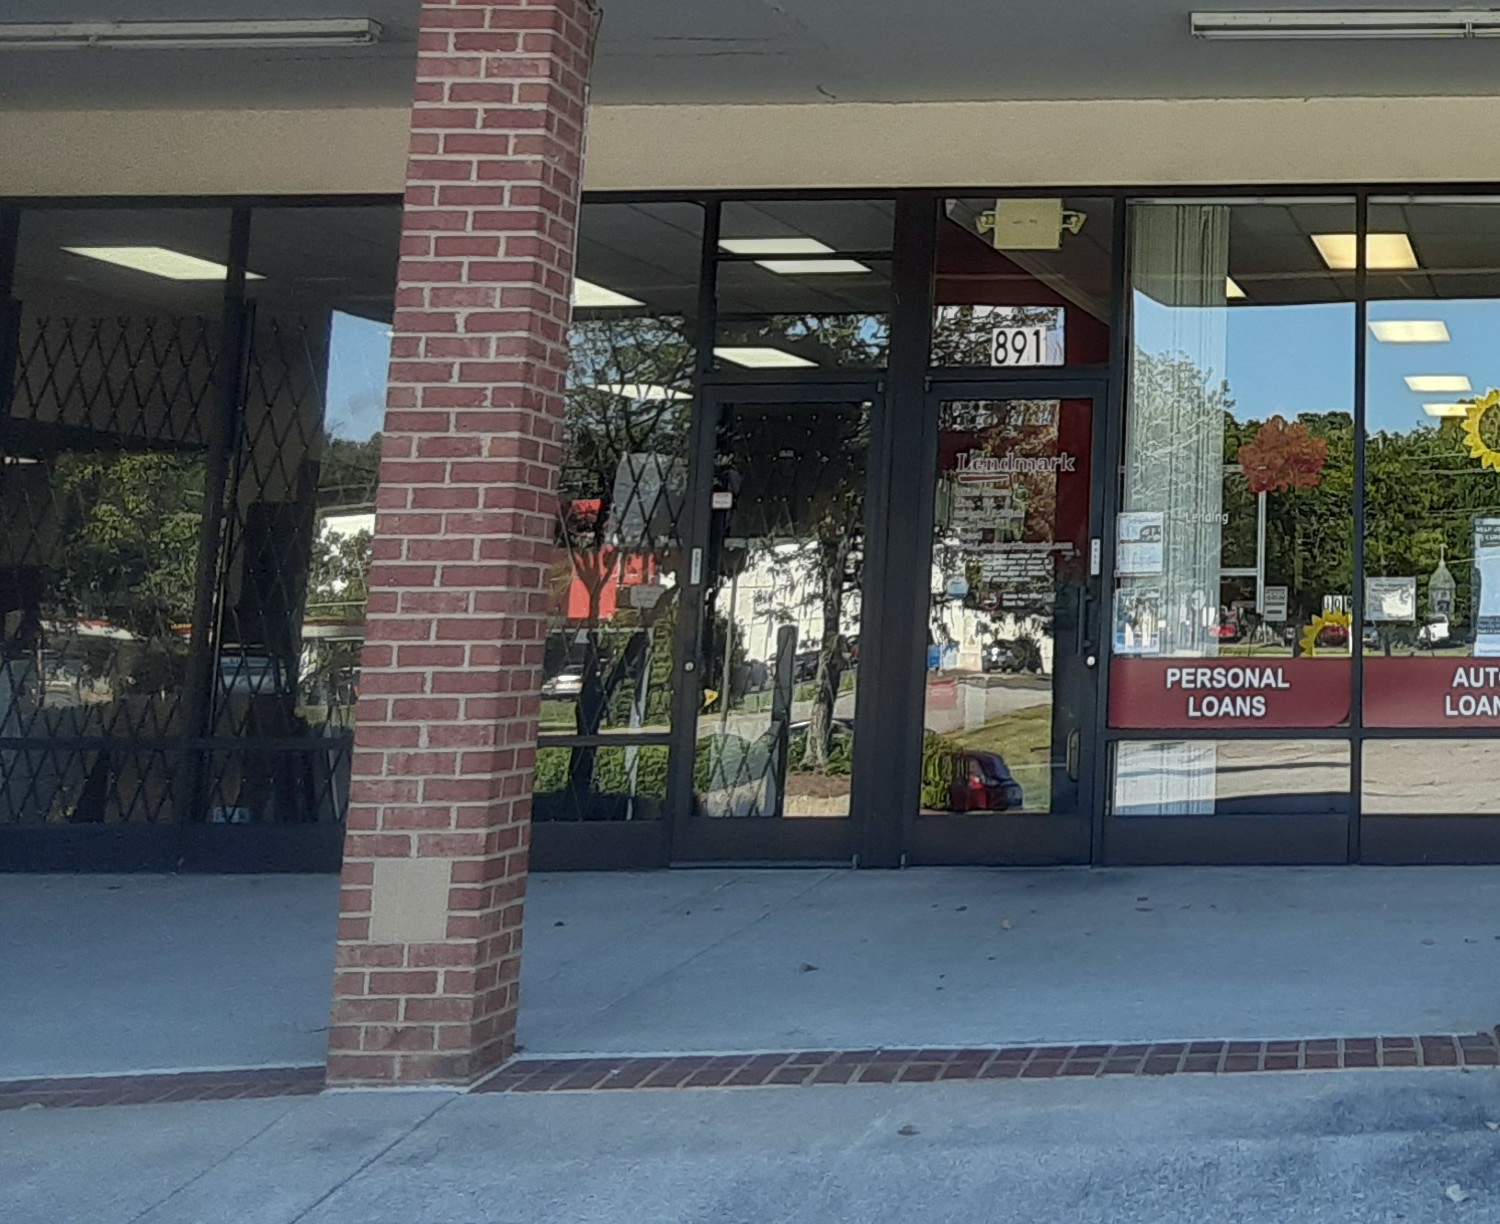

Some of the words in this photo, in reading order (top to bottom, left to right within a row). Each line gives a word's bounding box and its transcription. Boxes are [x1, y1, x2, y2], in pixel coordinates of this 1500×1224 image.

[993, 329, 1041, 365] 891
[956, 452, 1076, 473] Lendmark
[1166, 667, 1291, 688] PERSONAL
[1188, 696, 1267, 717] LOANS
